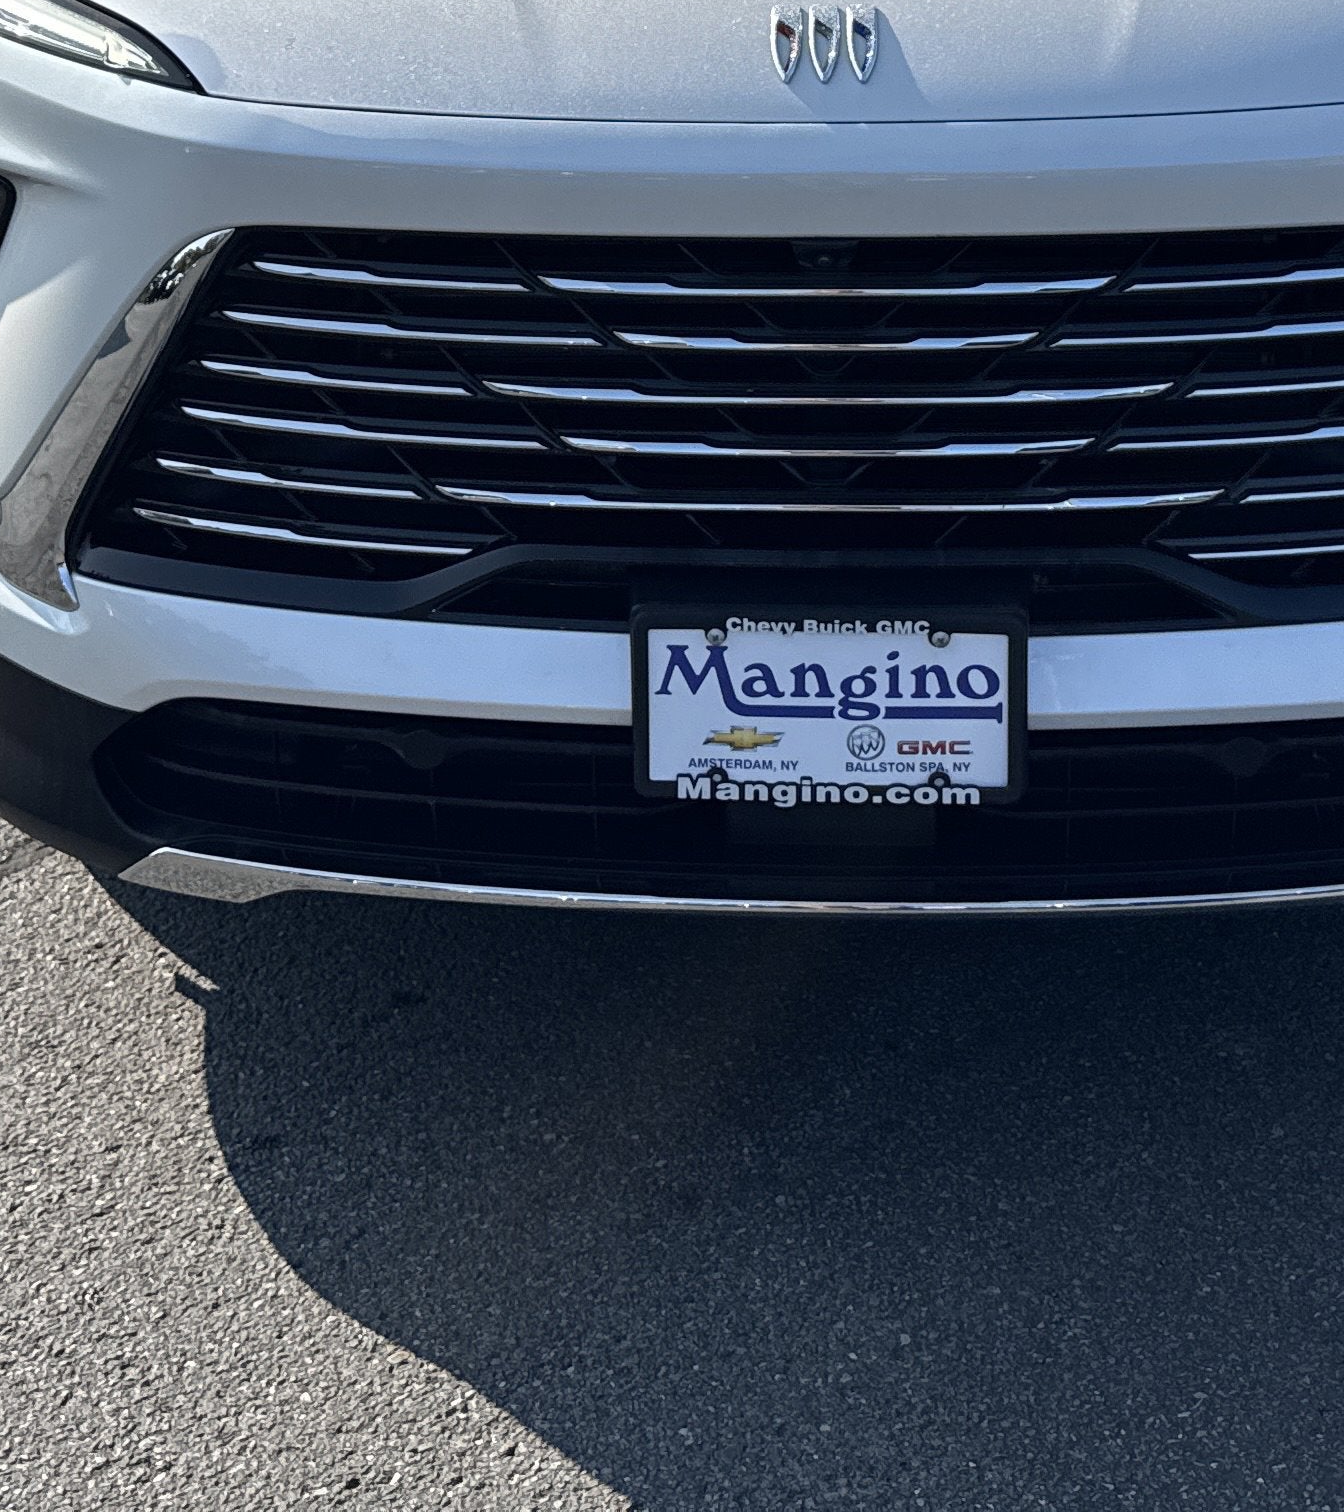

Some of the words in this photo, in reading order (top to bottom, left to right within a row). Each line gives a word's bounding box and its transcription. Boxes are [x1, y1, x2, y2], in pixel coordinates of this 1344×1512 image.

[726, 617, 796, 636] Chevy
[803, 619, 867, 635] Buick
[876, 620, 930, 636] GMC
[654, 644, 1002, 721] Mangino
[897, 740, 972, 755] GMC
[688, 757, 777, 772] AMSTERDAM,
[781, 760, 799, 771] NY
[845, 761, 915, 773] BALLSTON
[919, 761, 948, 774] SPA,
[952, 762, 971, 773] NY
[677, 776, 980, 808] Mangino.com
